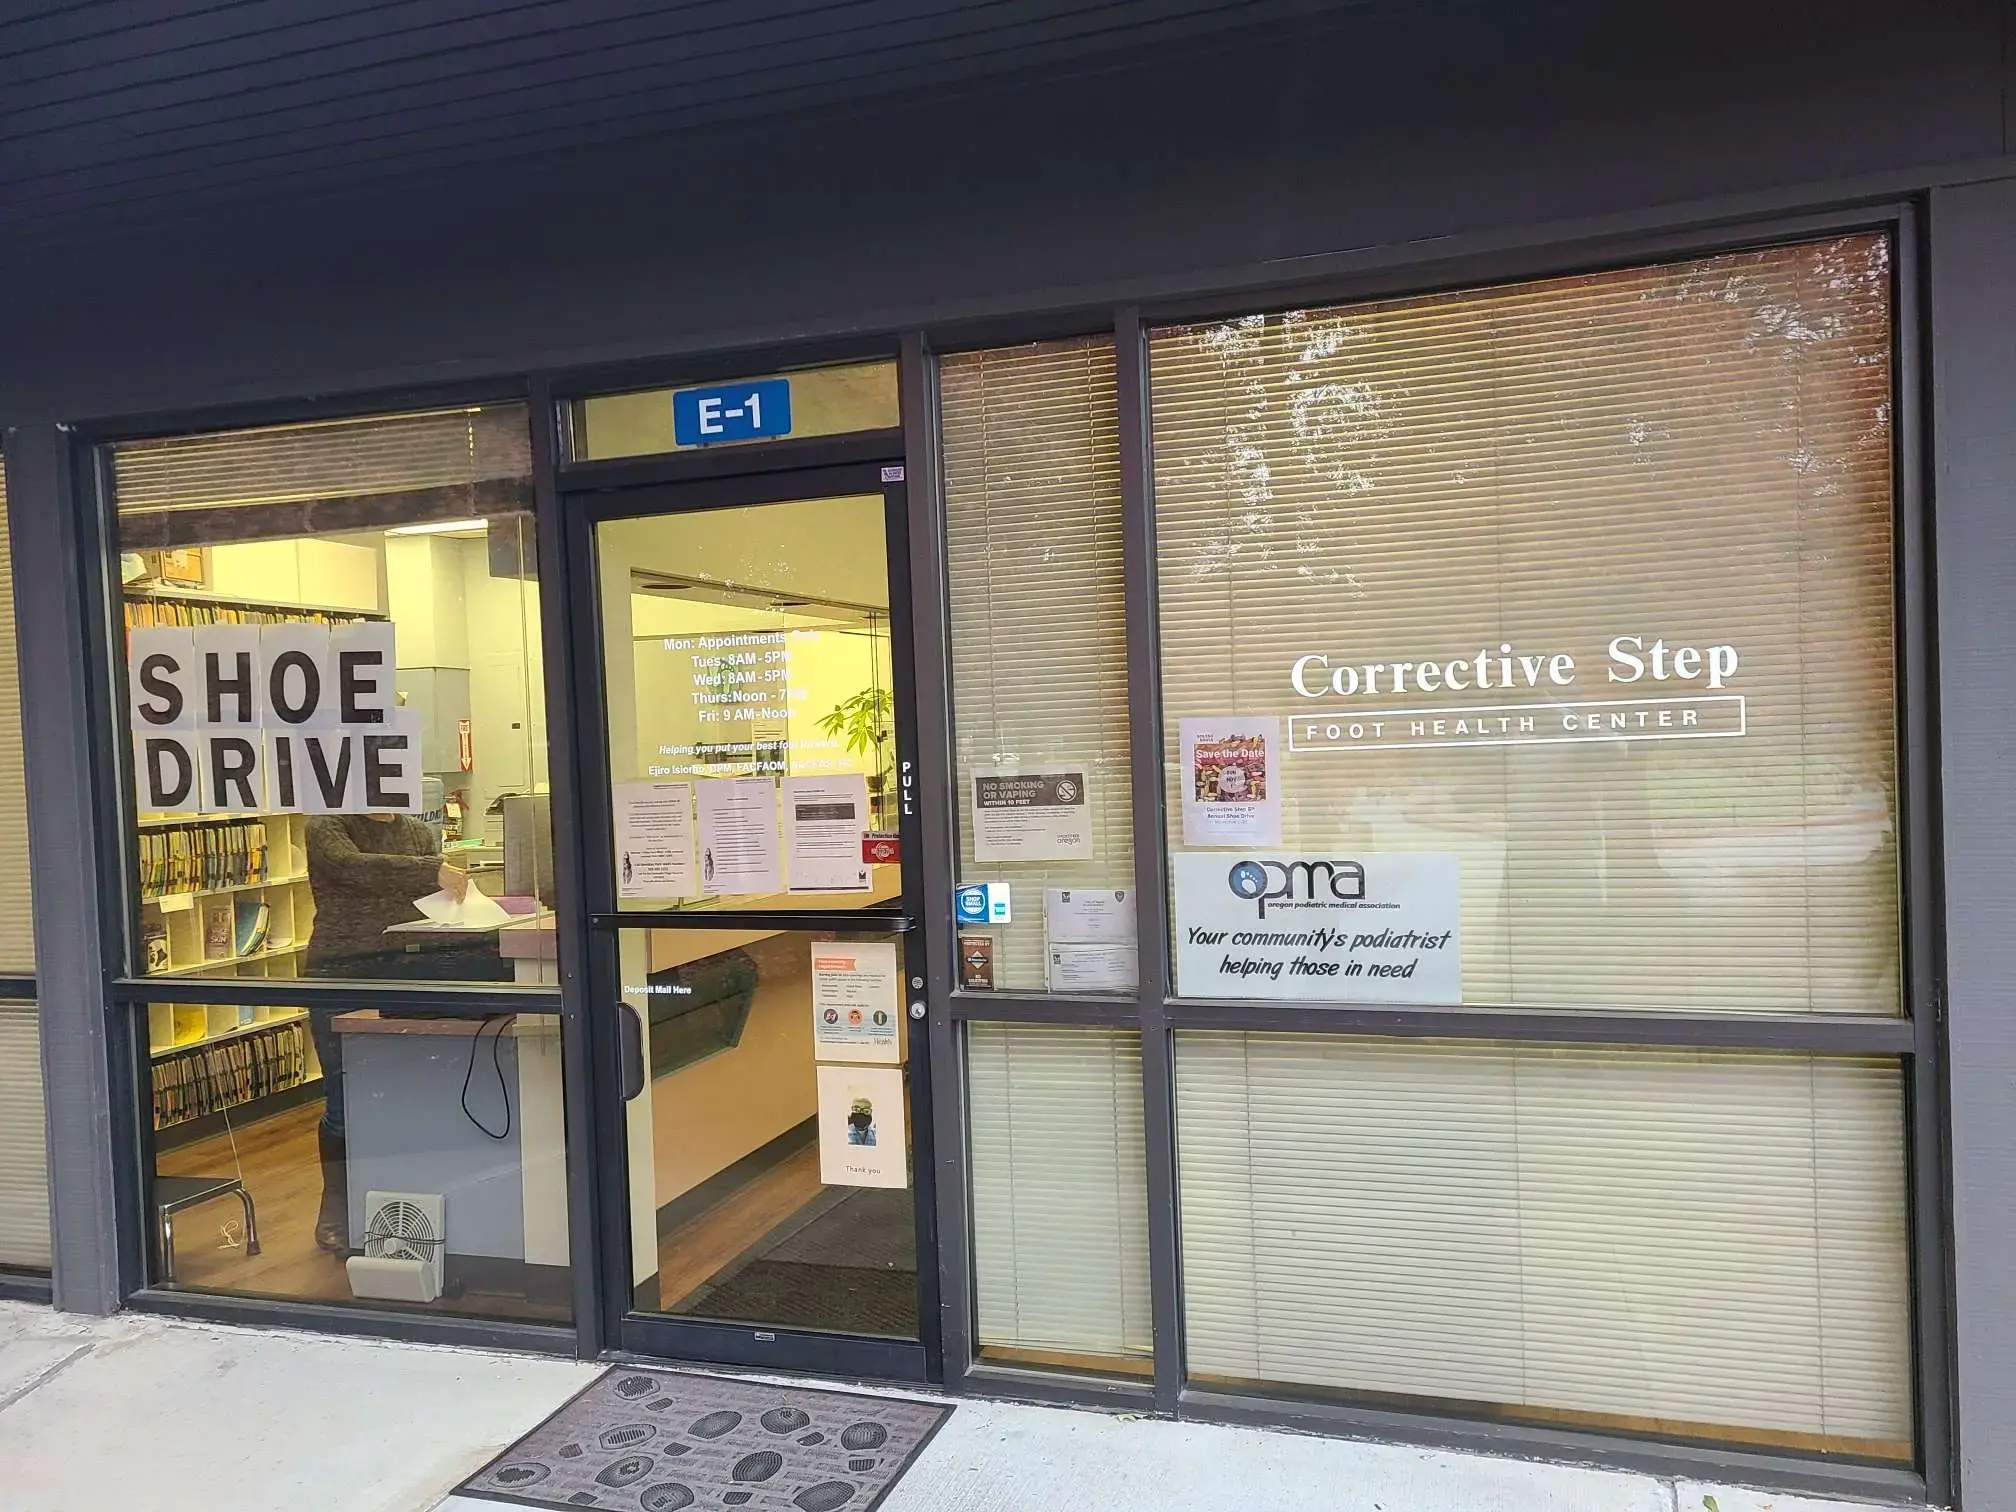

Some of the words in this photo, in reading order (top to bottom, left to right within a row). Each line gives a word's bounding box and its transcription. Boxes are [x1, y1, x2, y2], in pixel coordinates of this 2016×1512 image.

[699, 393, 761, 434] E-1
[664, 638, 695, 651] Mon:
[698, 632, 786, 650] Appointments
[1291, 643, 1575, 698] Corrective
[1607, 635, 1739, 689] Step
[693, 673, 726, 686] Wed:
[138, 650, 384, 725] SHOE
[698, 711, 720, 723] Fri:
[1306, 722, 1386, 741] FOOT
[1411, 715, 1536, 737] HEALTH
[1562, 709, 1698, 732] CENTER
[659, 745, 694, 755] Helping
[695, 744, 713, 754] you
[715, 743, 731, 753] put
[732, 743, 753, 753] your
[756, 741, 778, 750] best
[1196, 749, 1221, 759] Save
[1223, 749, 1239, 758] the
[1241, 749, 1264, 758] Date
[145, 735, 410, 809] DRIVE
[648, 765, 670, 776] Ejiro
[902, 761, 913, 815] PULL
[983, 782, 998, 791] NO
[999, 781, 1045, 790] SMOKING
[983, 791, 997, 799] OR
[999, 790, 1037, 799] VAPING
[1267, 902, 1294, 910] oregon
[1294, 901, 1327, 910] podiatric
[1328, 901, 1358, 909] medical
[1187, 927, 1229, 945] Your
[1231, 927, 1347, 952] community's
[1350, 928, 1452, 952] podiatrist
[1219, 955, 1284, 980] helping
[1289, 956, 1340, 977] those
[1345, 960, 1362, 977] in
[1367, 959, 1419, 979] need
[624, 985, 654, 996] Deposit
[655, 985, 672, 994] Mail
[673, 985, 692, 995] Here
[845, 1165, 866, 1174] Thank
[869, 1167, 881, 1175] you
